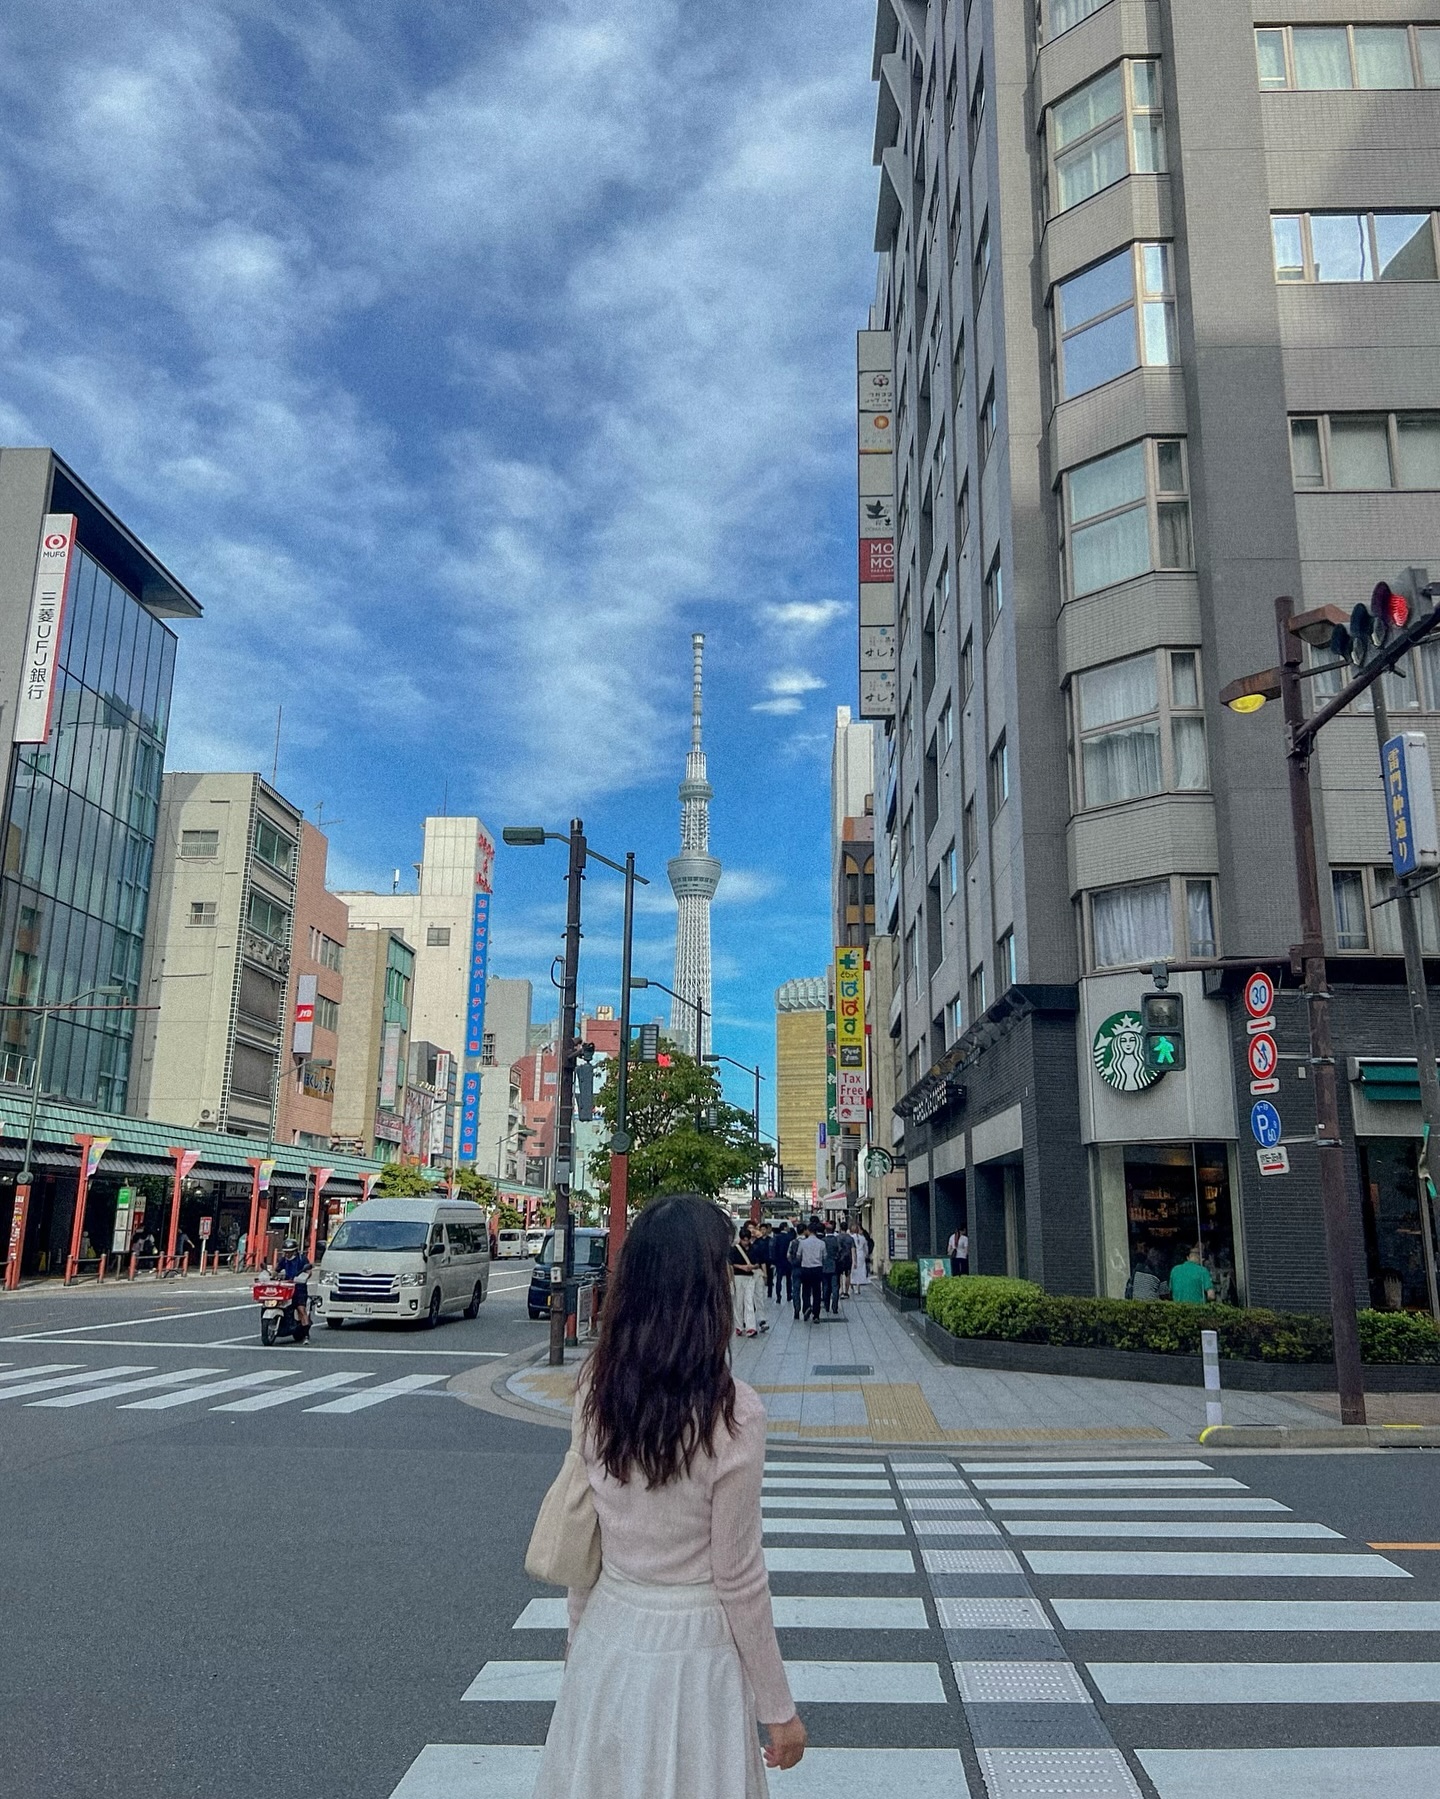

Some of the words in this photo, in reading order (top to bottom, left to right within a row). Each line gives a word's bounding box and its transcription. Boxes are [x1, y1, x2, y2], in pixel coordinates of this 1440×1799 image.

[870, 543, 894, 554] MO
[870, 557, 894, 569] MO
[28, 591, 56, 700] 三菱UFJ銀行
[1252, 985, 1267, 1005] 30
[298, 1009, 312, 1018] JTB
[843, 1073, 861, 1083] Tax
[840, 1085, 864, 1095] Free
[1256, 1114, 1269, 1143] P
